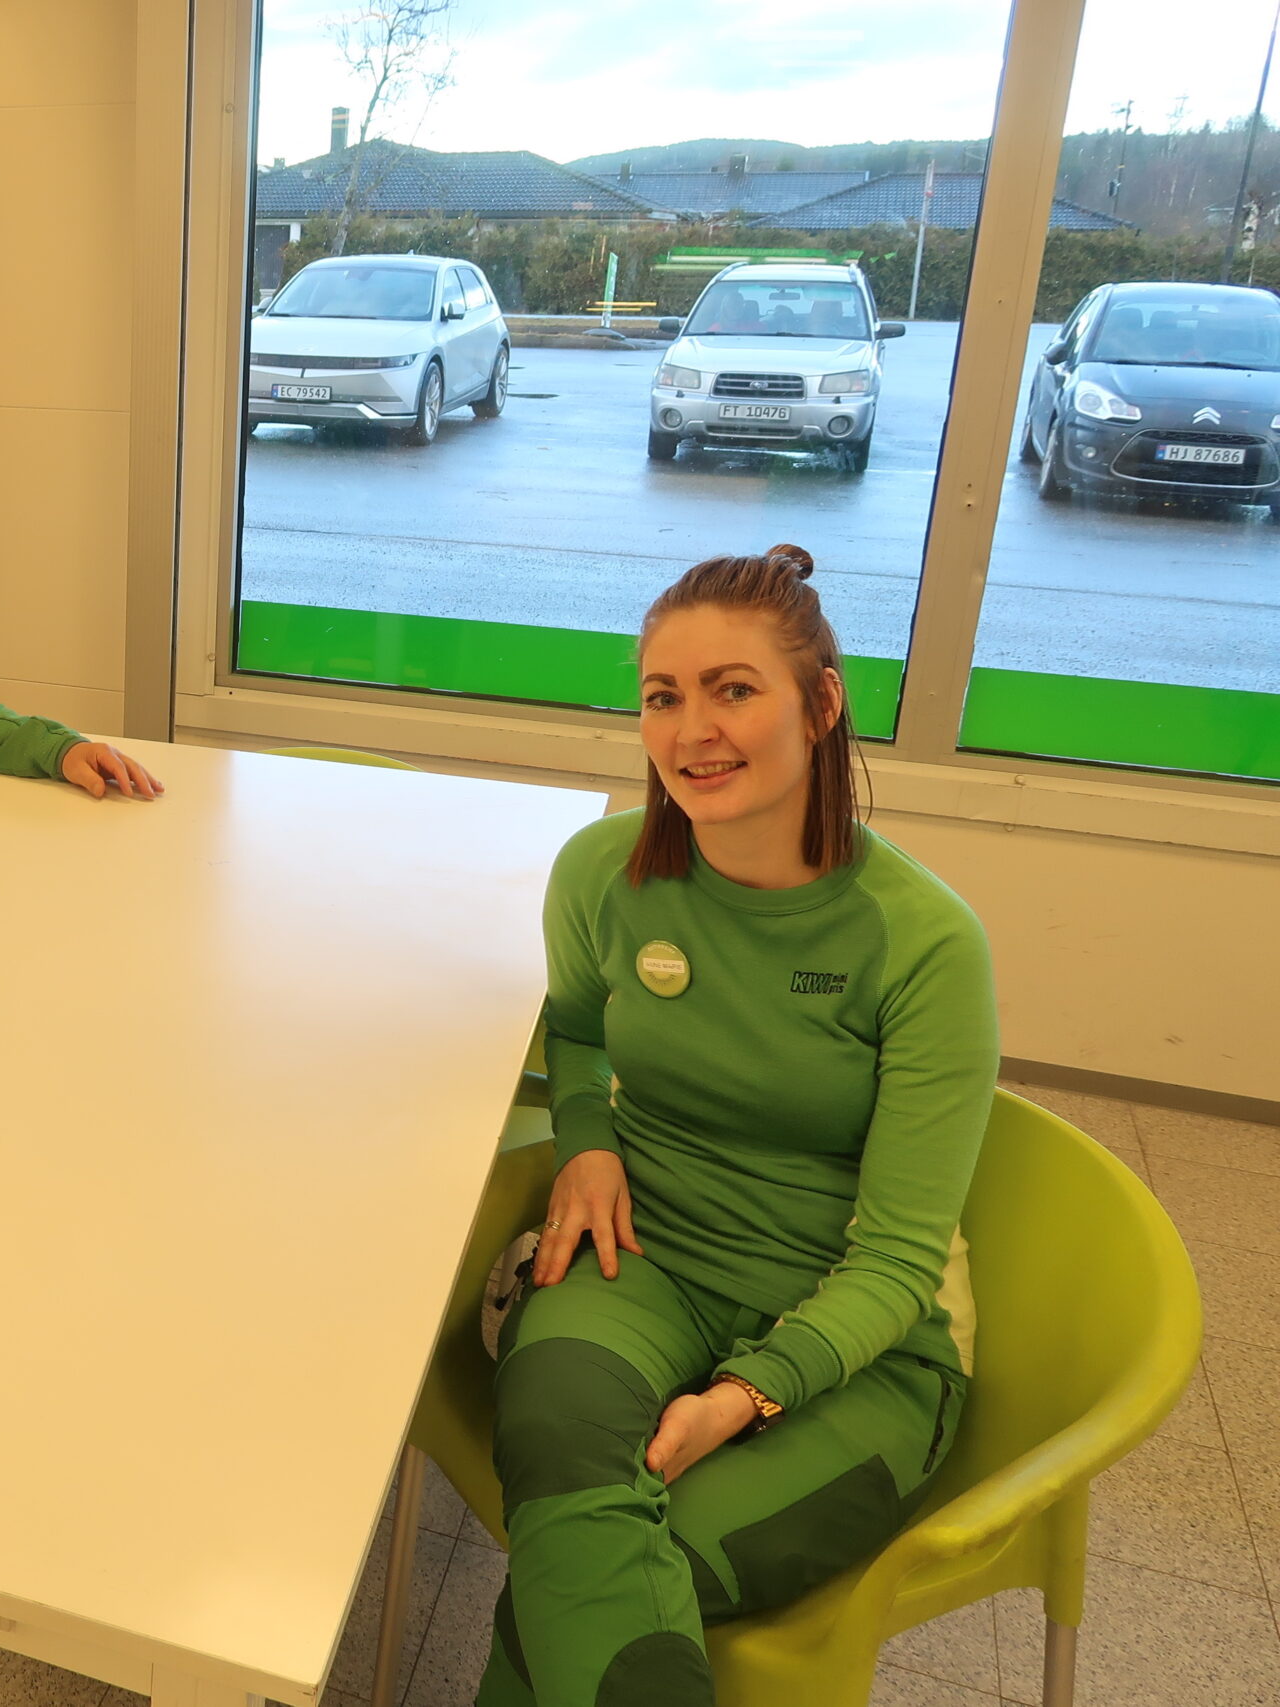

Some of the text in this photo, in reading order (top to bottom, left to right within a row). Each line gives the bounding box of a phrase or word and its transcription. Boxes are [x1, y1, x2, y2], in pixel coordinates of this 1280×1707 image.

[280, 387, 327, 398] EC 79542
[723, 405, 787, 418] FT 10476
[1169, 448, 1240, 463] HJ 87686
